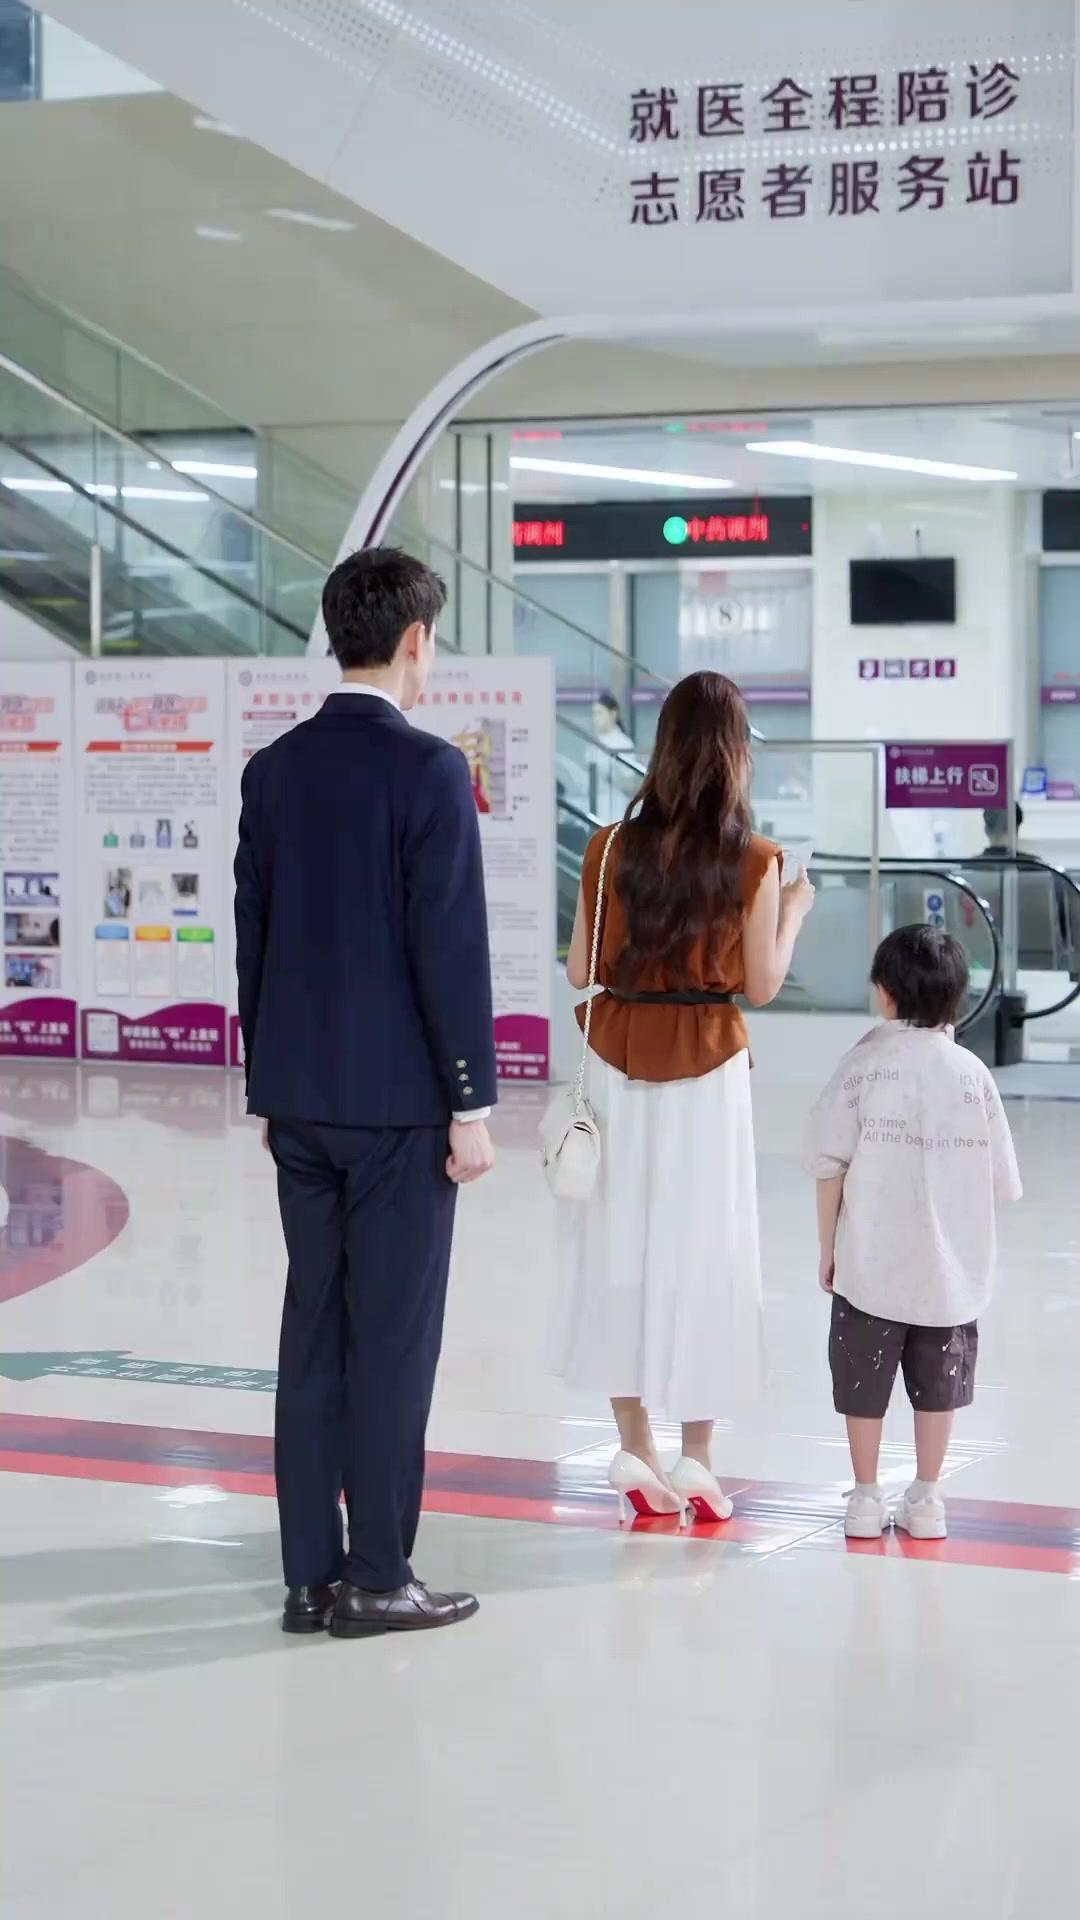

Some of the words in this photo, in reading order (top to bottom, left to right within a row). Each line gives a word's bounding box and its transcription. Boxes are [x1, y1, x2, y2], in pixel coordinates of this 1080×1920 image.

[629, 62, 1020, 143] 就医全程陪诊
[630, 149, 1021, 226] 志愿者服务站
[895, 765, 963, 785] 扶梯上行
[865, 1068, 900, 1082] child
[863, 1117, 876, 1129] to
[863, 1132, 878, 1142] All
[881, 1132, 901, 1144] the
[953, 1136, 975, 1149] the
